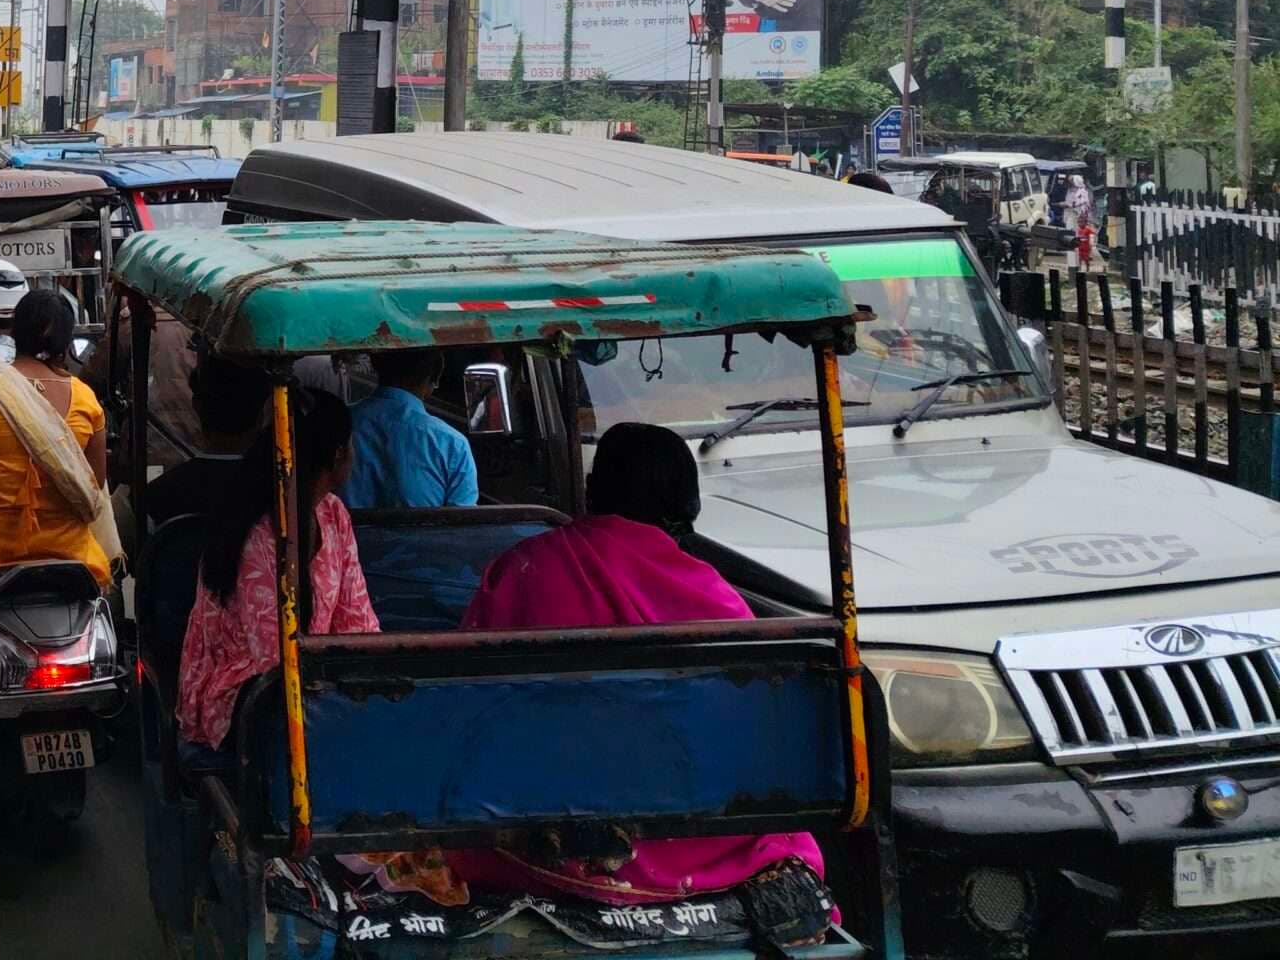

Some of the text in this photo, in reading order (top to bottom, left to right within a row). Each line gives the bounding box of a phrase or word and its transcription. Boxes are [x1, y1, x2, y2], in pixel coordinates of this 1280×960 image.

[989, 534, 1200, 574] SPORTS
[1179, 871, 1197, 882] IND
[400, 913, 447, 934] भोग
[598, 902, 717, 930] गोविंद भोग
